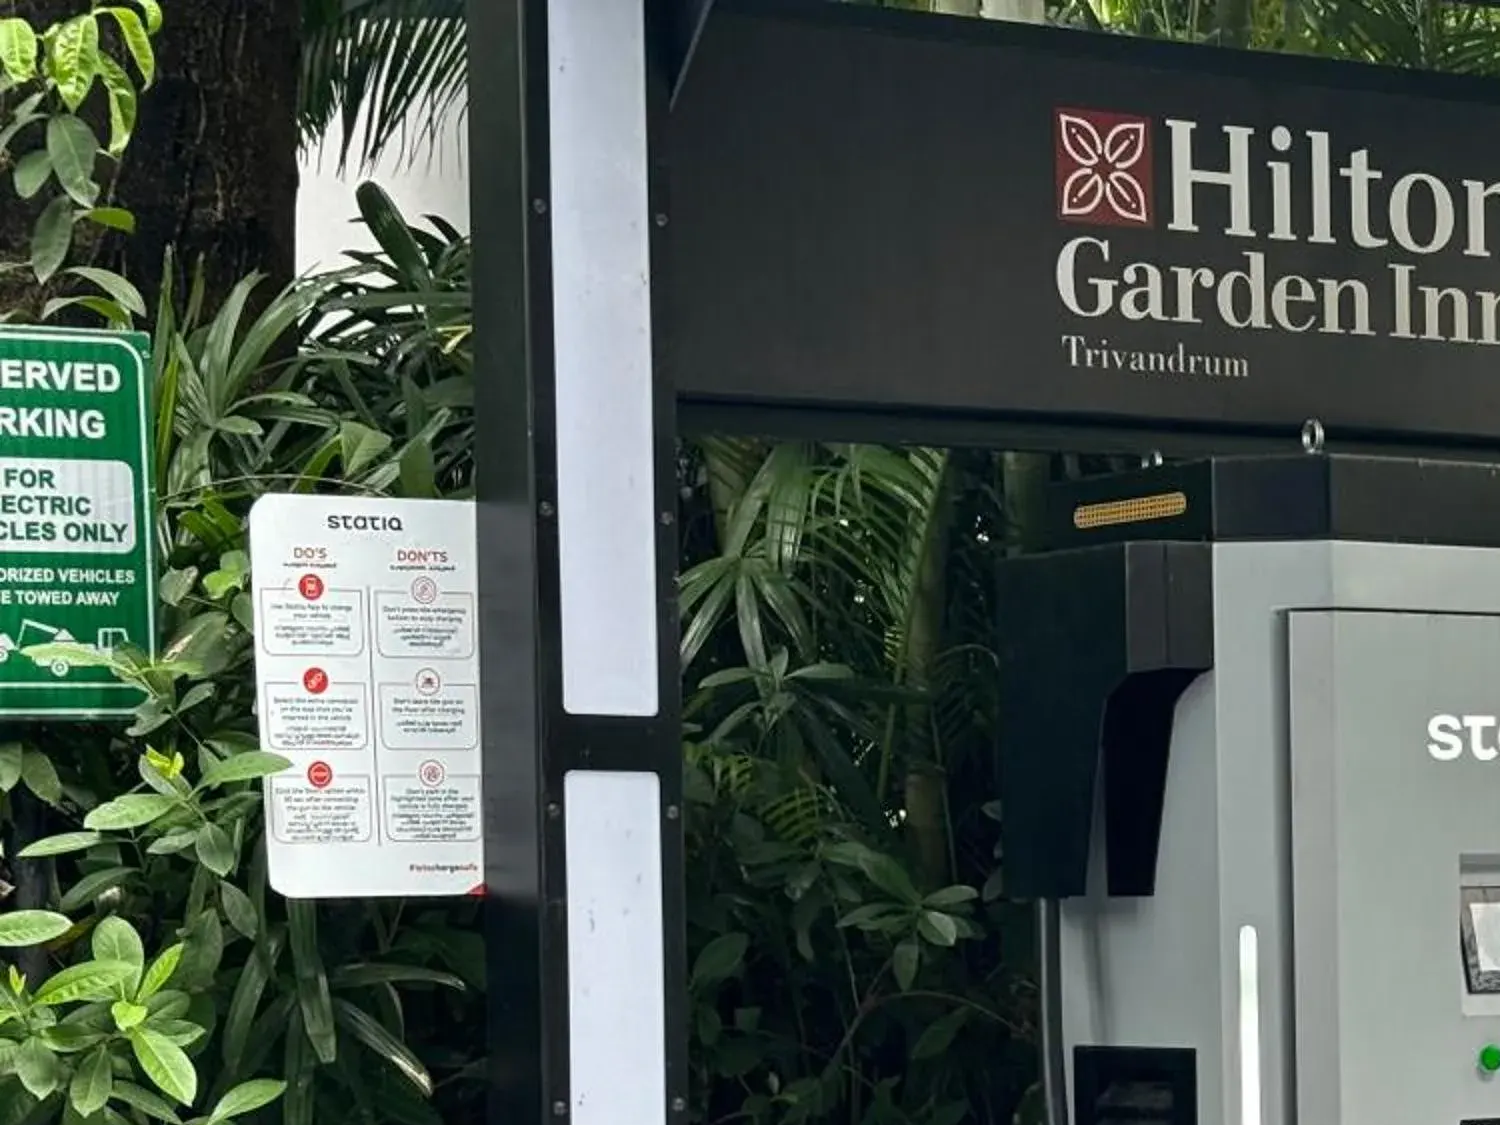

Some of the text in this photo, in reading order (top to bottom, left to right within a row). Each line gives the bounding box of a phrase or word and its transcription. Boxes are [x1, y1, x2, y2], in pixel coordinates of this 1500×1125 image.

[1055, 236, 1377, 335] Garden
[1061, 335, 1250, 378] Trivandrum
[0, 359, 122, 393] ERVED
[0, 406, 107, 438] RKING
[5, 468, 56, 489] FOR
[63, 523, 129, 543] ONLY
[293, 546, 328, 559] DO'S
[397, 549, 448, 563] DON'TS
[57, 568, 136, 584] VEHICLES
[16, 590, 73, 606] TOWED
[75, 591, 121, 607] AWAY
